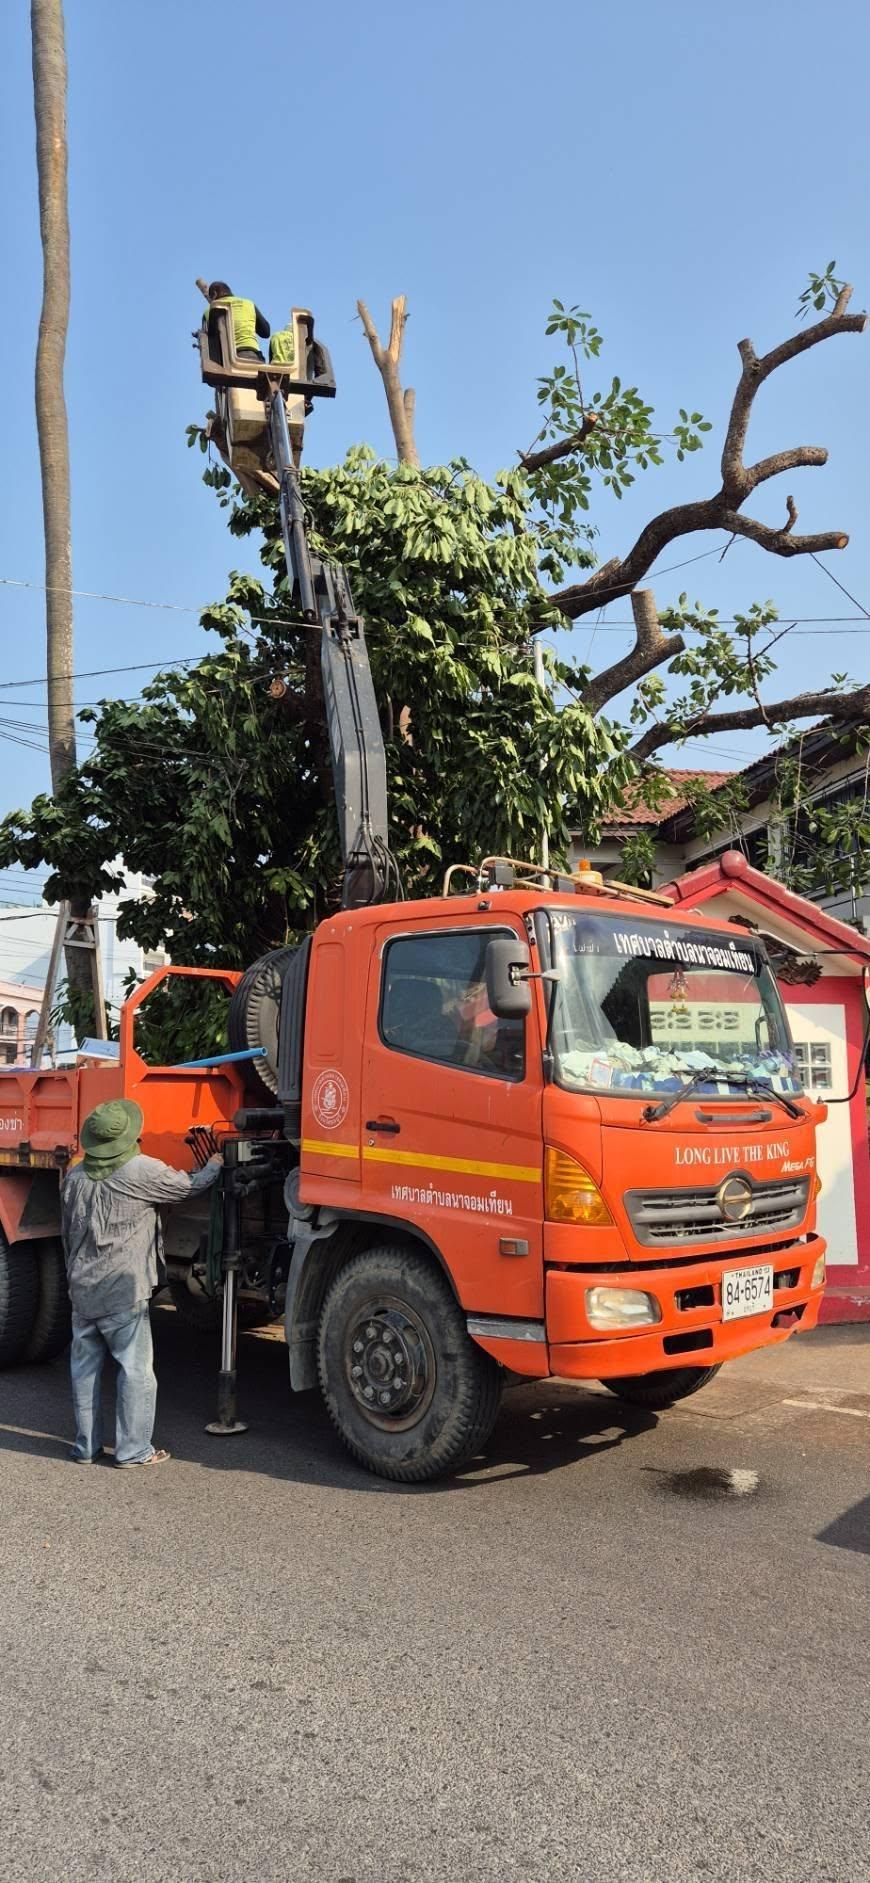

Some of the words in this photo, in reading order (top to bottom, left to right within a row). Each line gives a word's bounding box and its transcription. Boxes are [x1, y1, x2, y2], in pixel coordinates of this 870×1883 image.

[613, 930, 755, 973] เทศบาลตำบลนาจอมเทียน
[675, 1147, 711, 1165] LONG
[714, 1146, 741, 1164] LIVE
[743, 1144, 764, 1162] THE
[766, 1141, 790, 1160] KING
[391, 1182, 513, 1215] เทศบาลตำบลนาจอมเทียน
[735, 1268, 763, 1279] THAILAND
[726, 1275, 771, 1306] 84-6574
